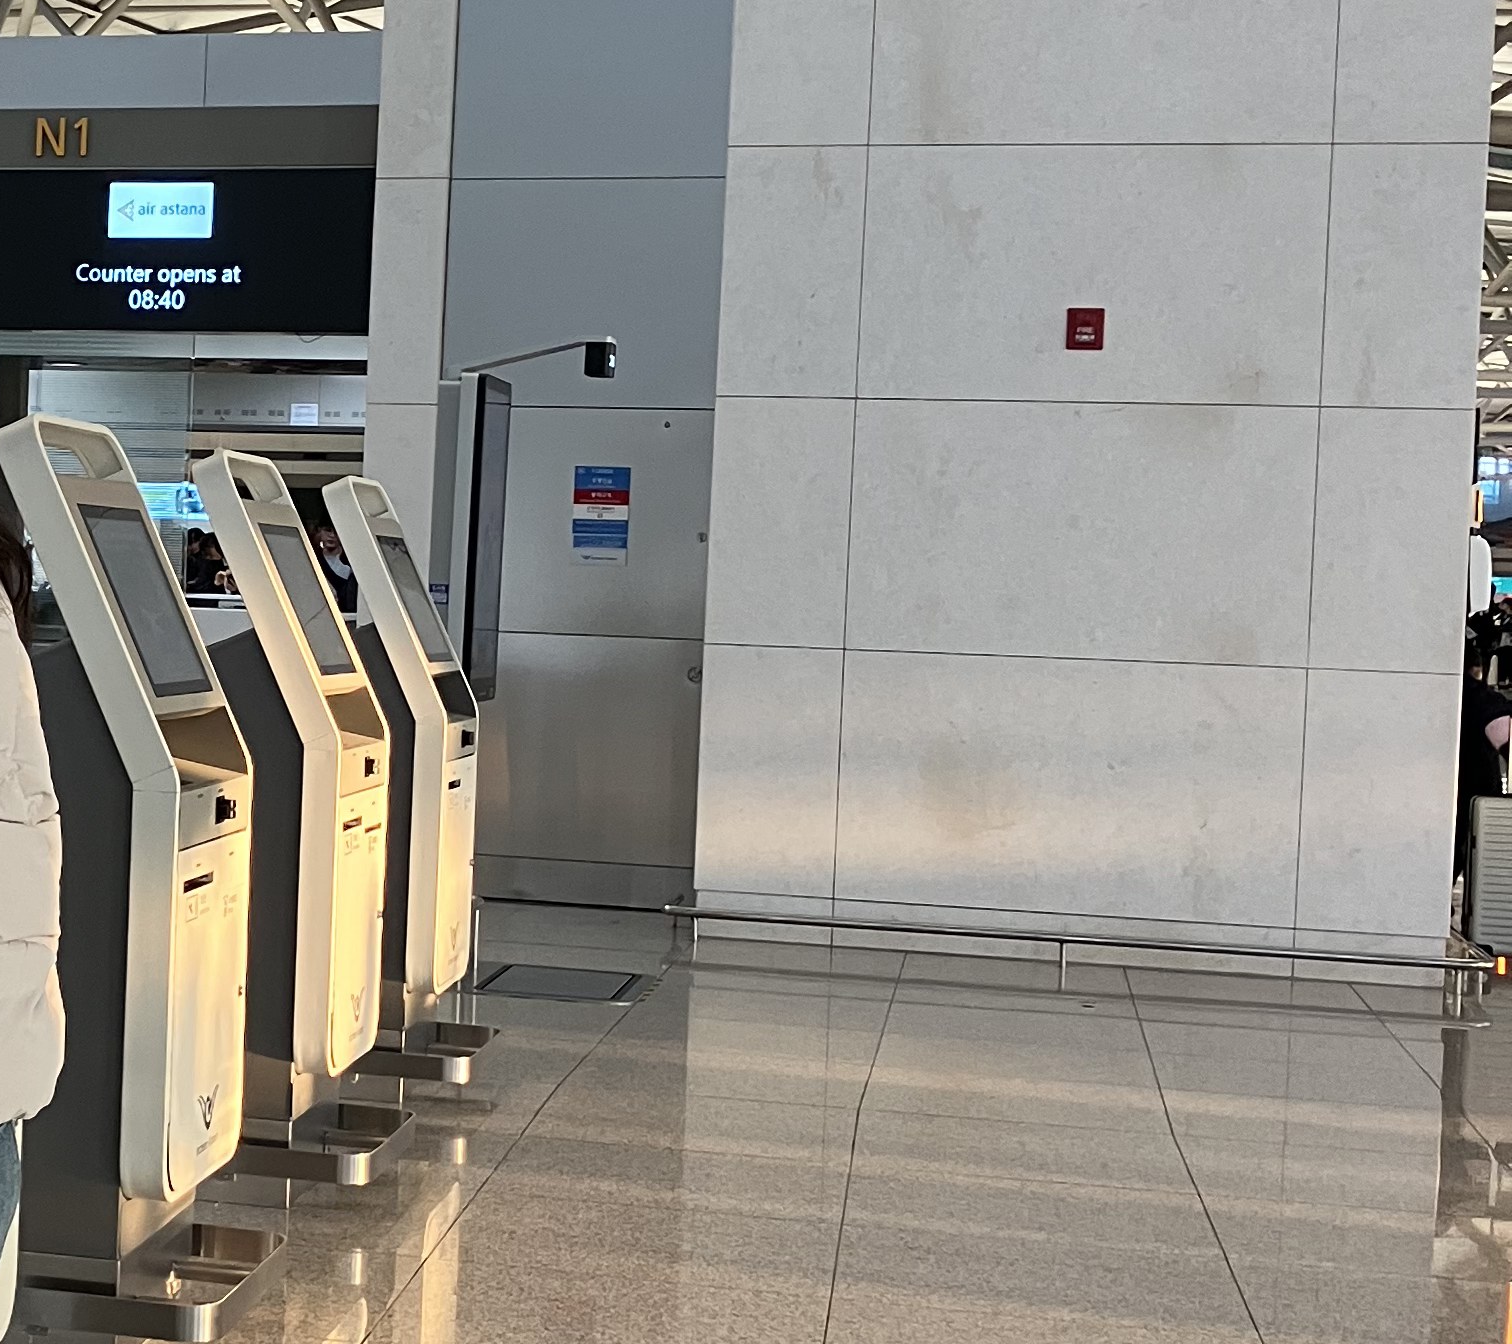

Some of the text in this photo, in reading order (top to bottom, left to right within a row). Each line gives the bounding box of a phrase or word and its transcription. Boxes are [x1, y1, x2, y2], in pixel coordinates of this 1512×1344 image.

[34, 117, 90, 158] N1
[138, 202, 206, 216] air astana
[75, 263, 242, 288] Counter opens at
[128, 288, 186, 311] 08:40
